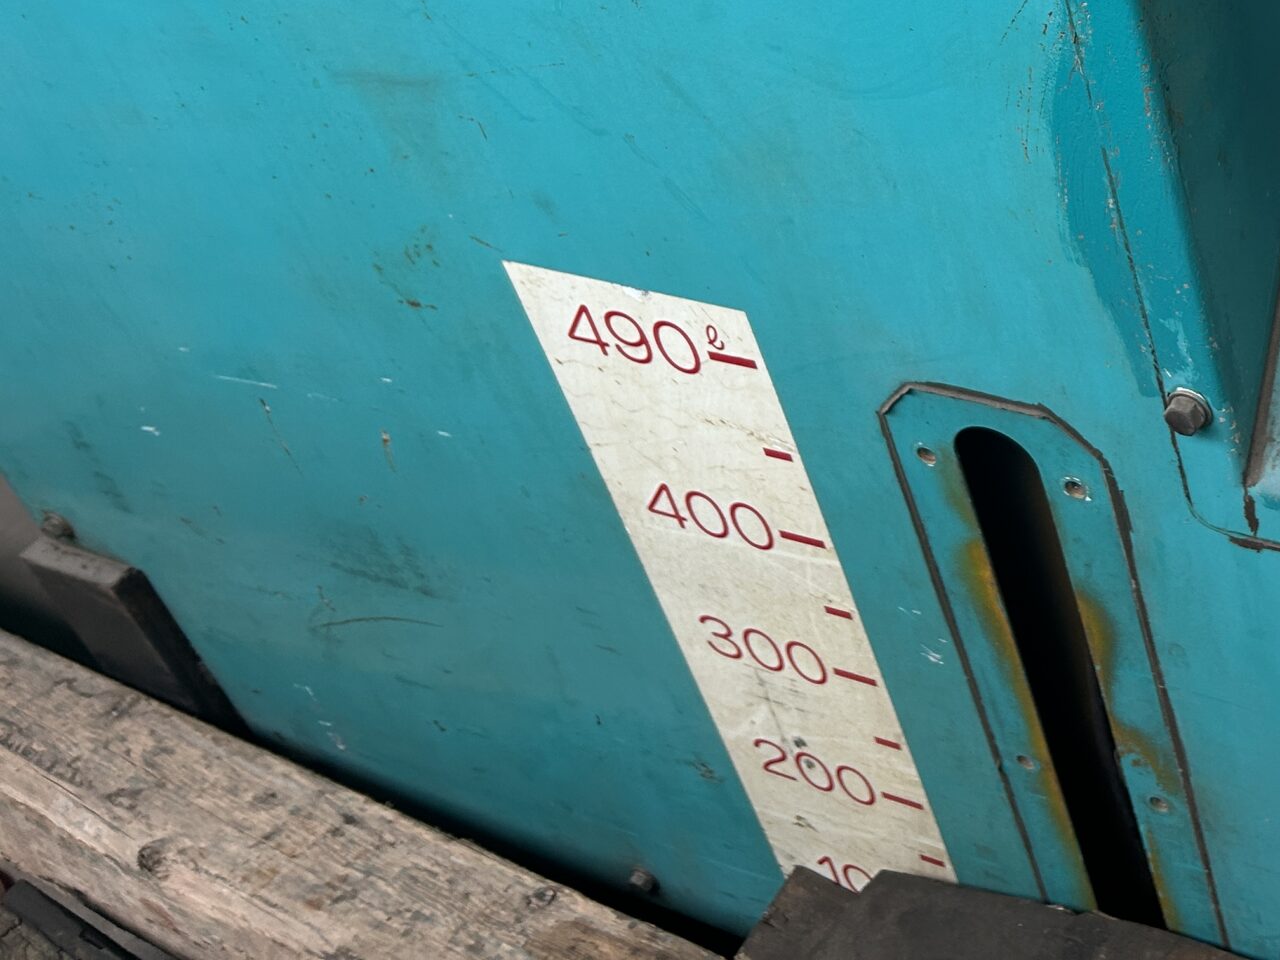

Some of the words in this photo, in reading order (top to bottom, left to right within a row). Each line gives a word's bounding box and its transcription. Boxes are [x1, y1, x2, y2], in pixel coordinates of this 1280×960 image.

[648, 483, 775, 550] 400
[698, 615, 827, 685] 300
[754, 738, 875, 806] 200
